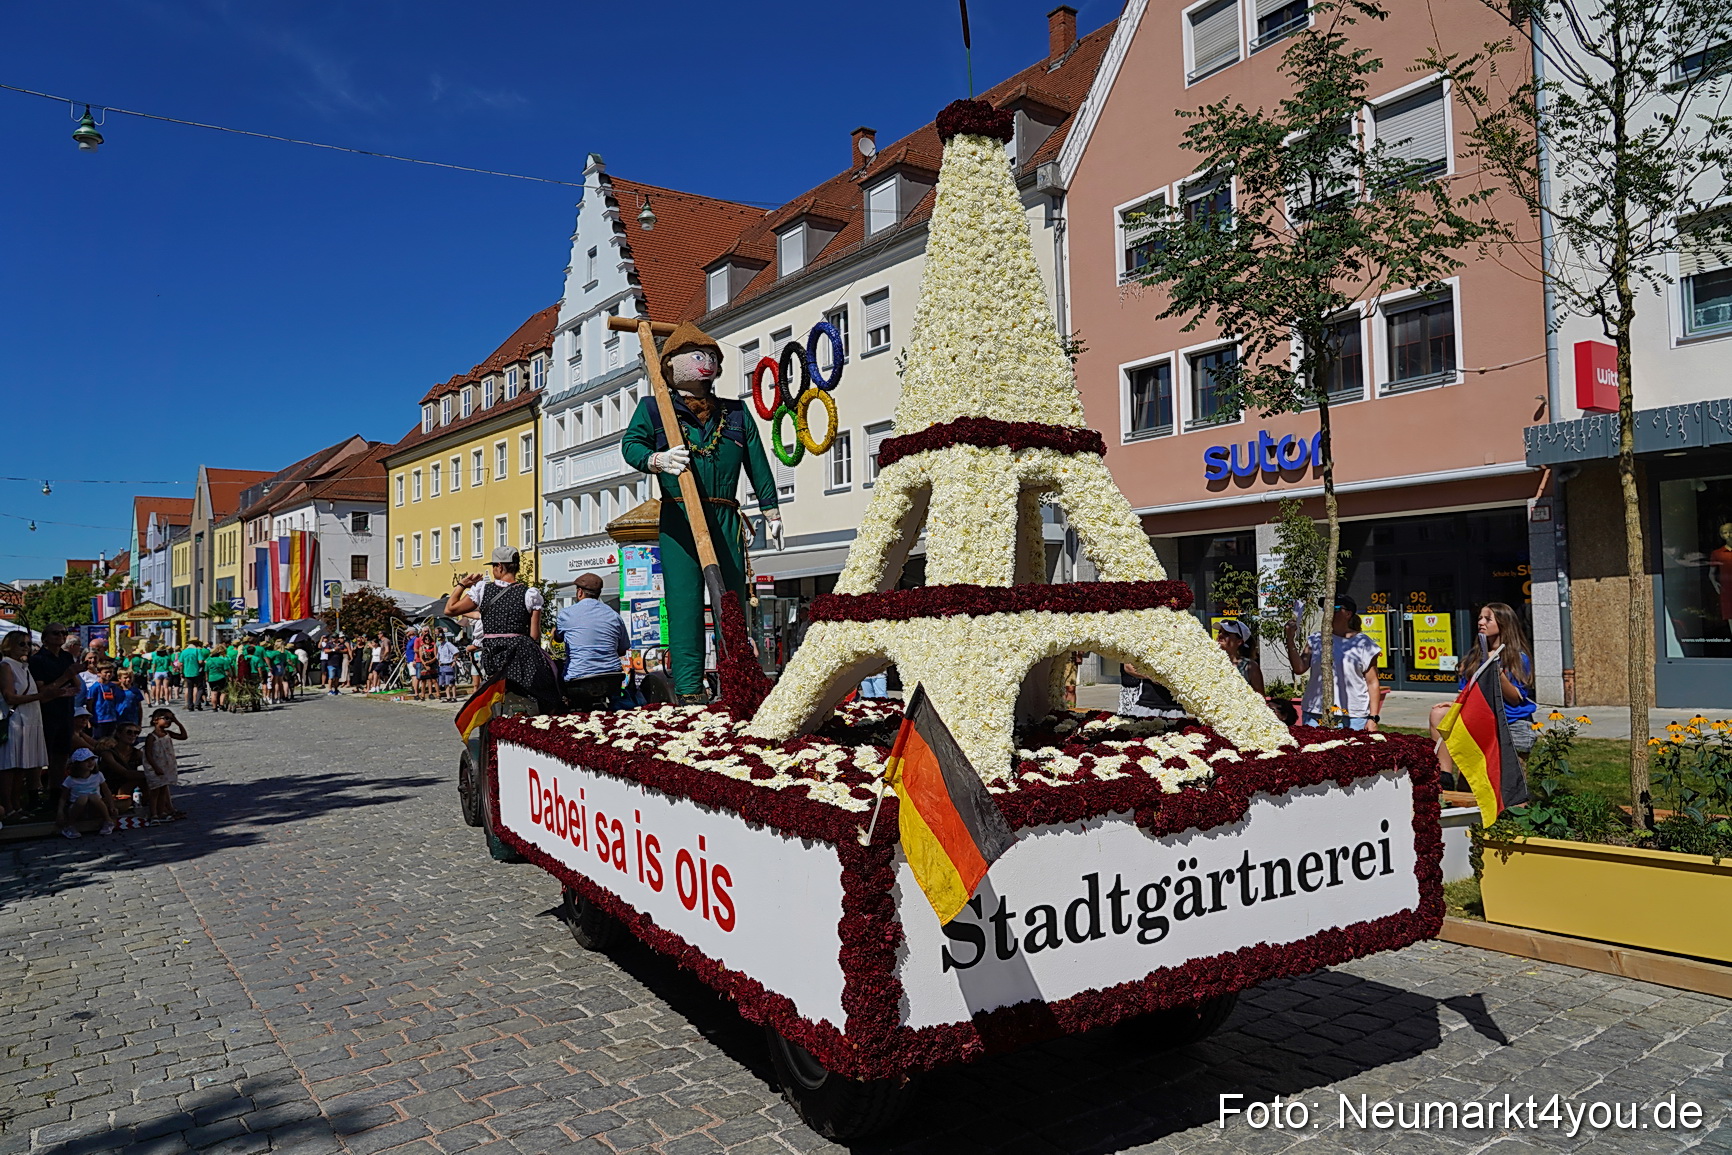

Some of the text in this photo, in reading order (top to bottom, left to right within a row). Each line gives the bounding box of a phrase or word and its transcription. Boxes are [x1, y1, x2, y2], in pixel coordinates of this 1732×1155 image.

[1418, 646, 1449, 660] 50%
[528, 767, 736, 932] Dabei sa is ois
[942, 819, 1394, 974] Stadtgärtnerei
